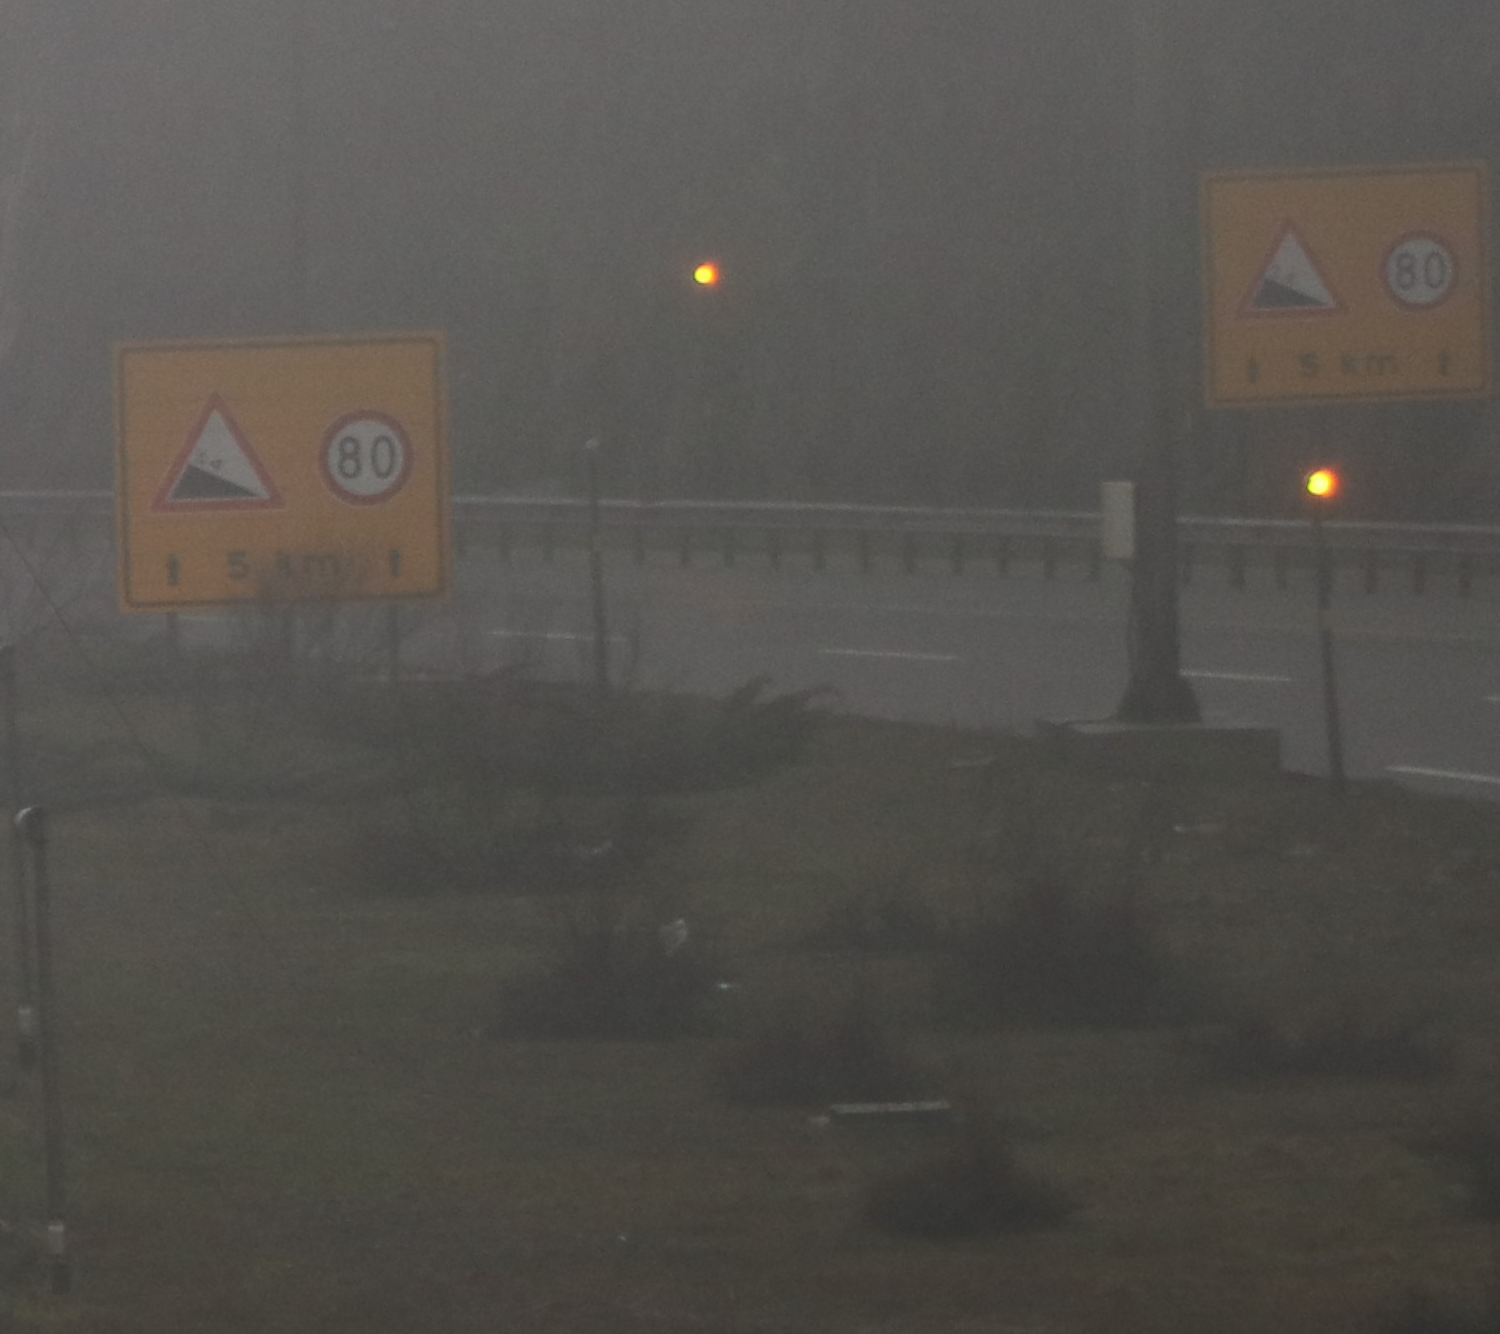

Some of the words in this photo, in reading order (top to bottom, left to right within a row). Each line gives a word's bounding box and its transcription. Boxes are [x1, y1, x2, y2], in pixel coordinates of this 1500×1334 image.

[1395, 251, 1448, 290] 80
[336, 435, 397, 481] 80
[226, 549, 251, 580] 5
